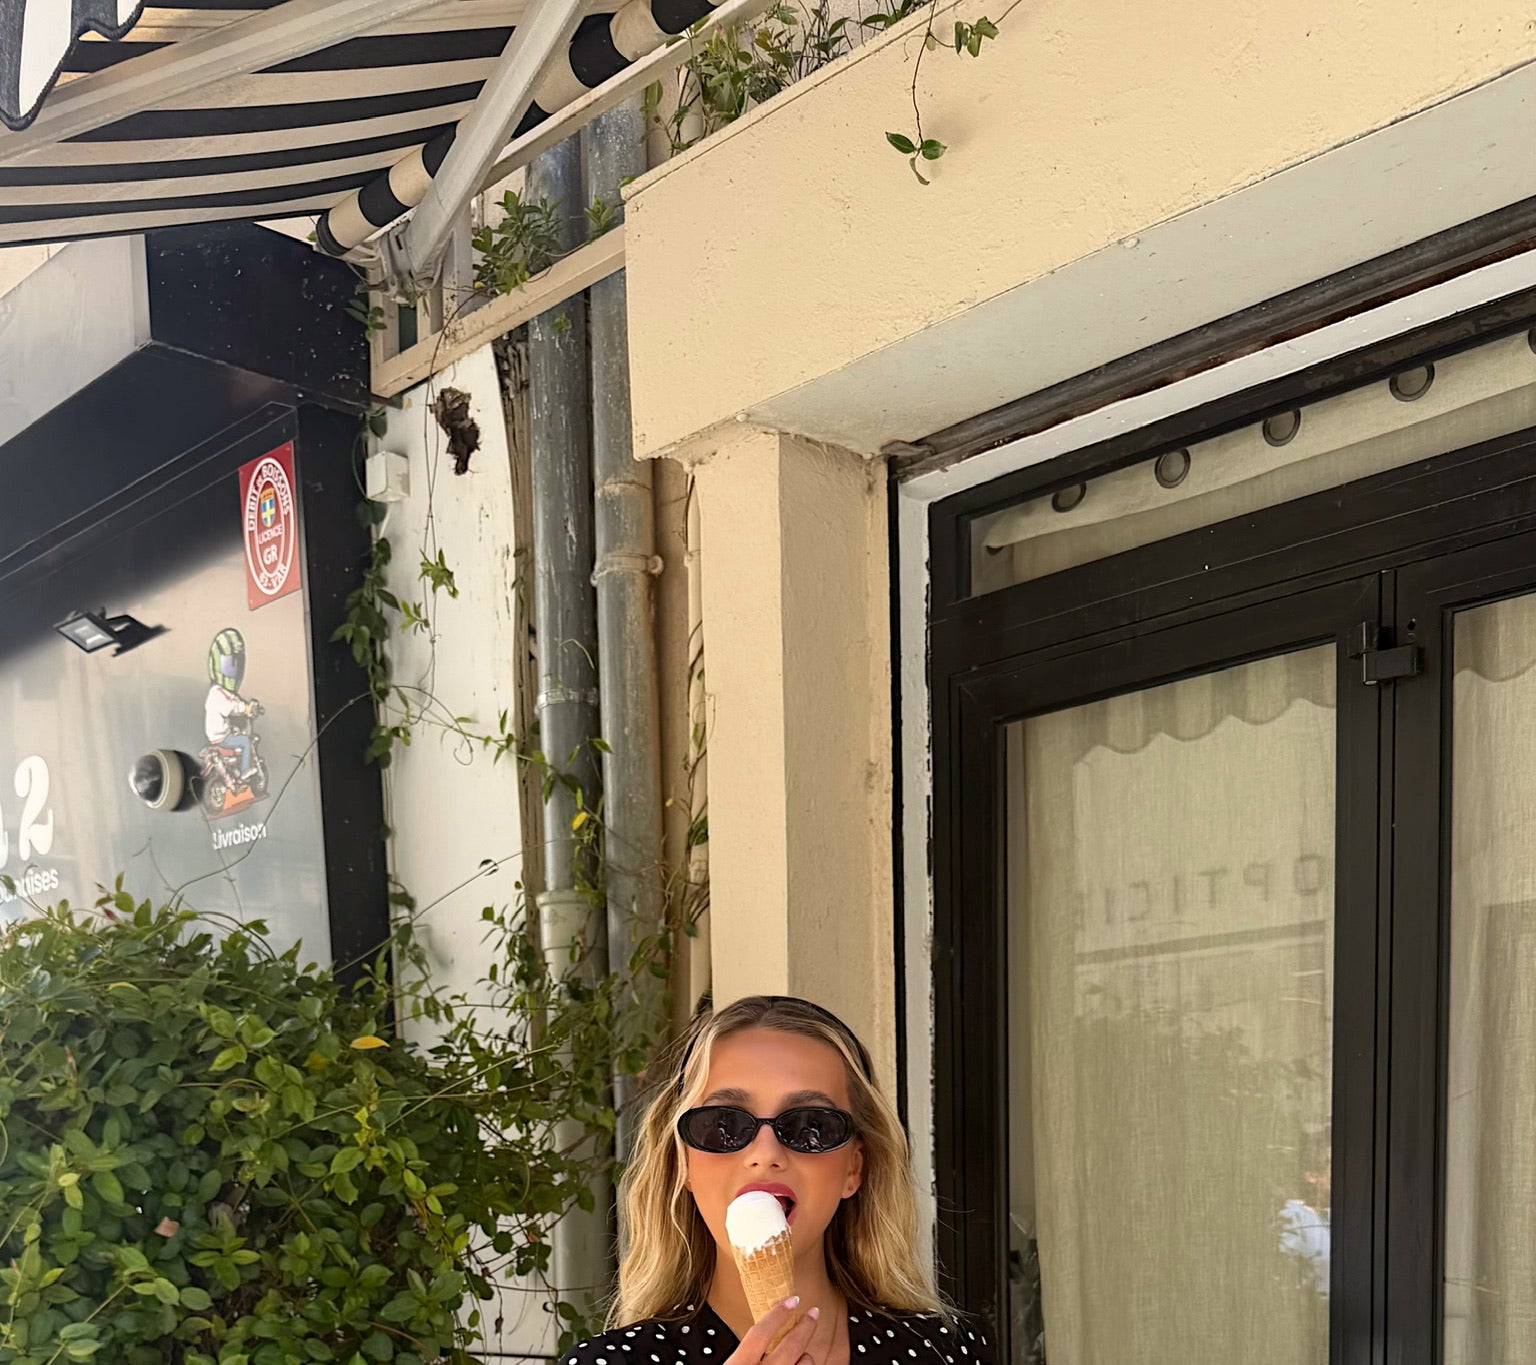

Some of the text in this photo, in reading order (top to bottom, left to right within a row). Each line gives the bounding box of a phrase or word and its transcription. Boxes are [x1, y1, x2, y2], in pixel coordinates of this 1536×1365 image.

[261, 464, 291, 515] BOISSONS
[259, 523, 283, 545] LICENCE
[263, 544, 278, 565] GR
[212, 823, 267, 850] Livraison
